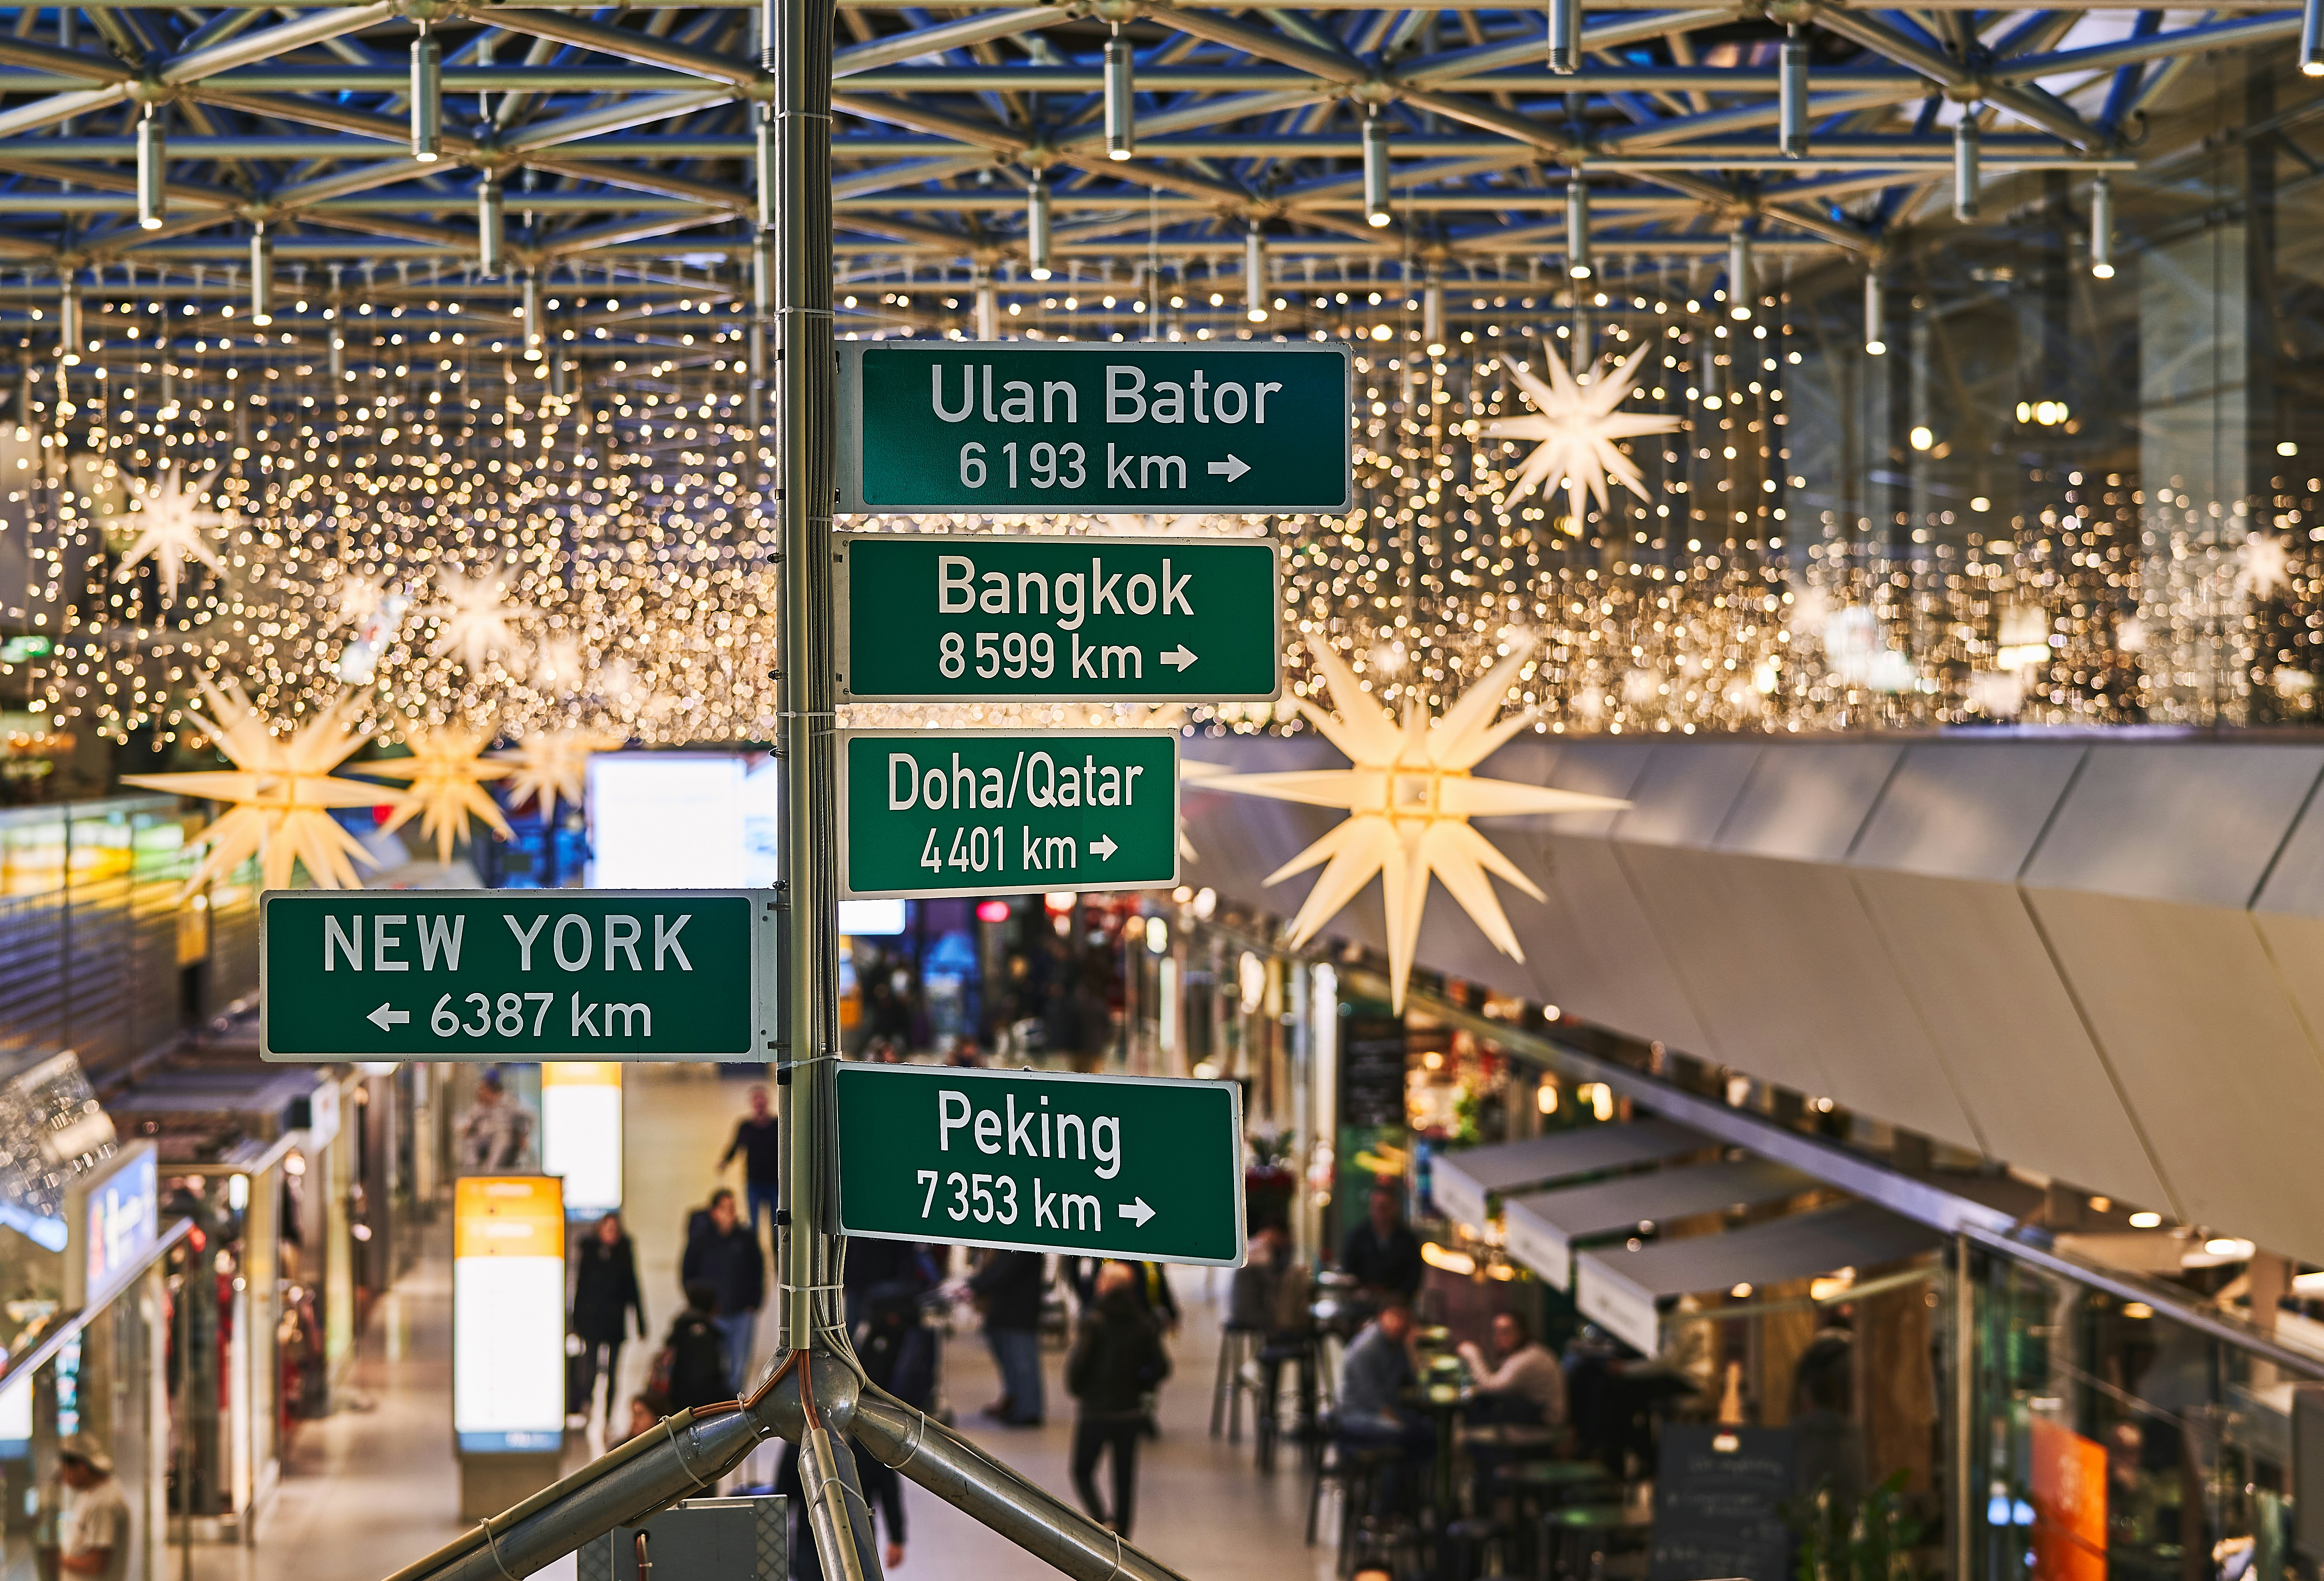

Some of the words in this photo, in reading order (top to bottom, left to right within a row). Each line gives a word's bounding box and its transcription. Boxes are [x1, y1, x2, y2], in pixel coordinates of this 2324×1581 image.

[931, 364, 1078, 424] Ulan
[1106, 364, 1283, 424] Bator
[1107, 442, 1187, 489] km
[938, 555, 1195, 631] Bangkok
[1071, 632, 1143, 679] km
[888, 750, 1145, 811] Doha/Qatar
[1023, 825, 1077, 871] km
[324, 914, 466, 972] NEW
[502, 913, 694, 973] YORK
[430, 992, 554, 1038] 6387
[571, 990, 652, 1037] km
[938, 1089, 1121, 1180] Peking
[1033, 1177, 1102, 1233] km
